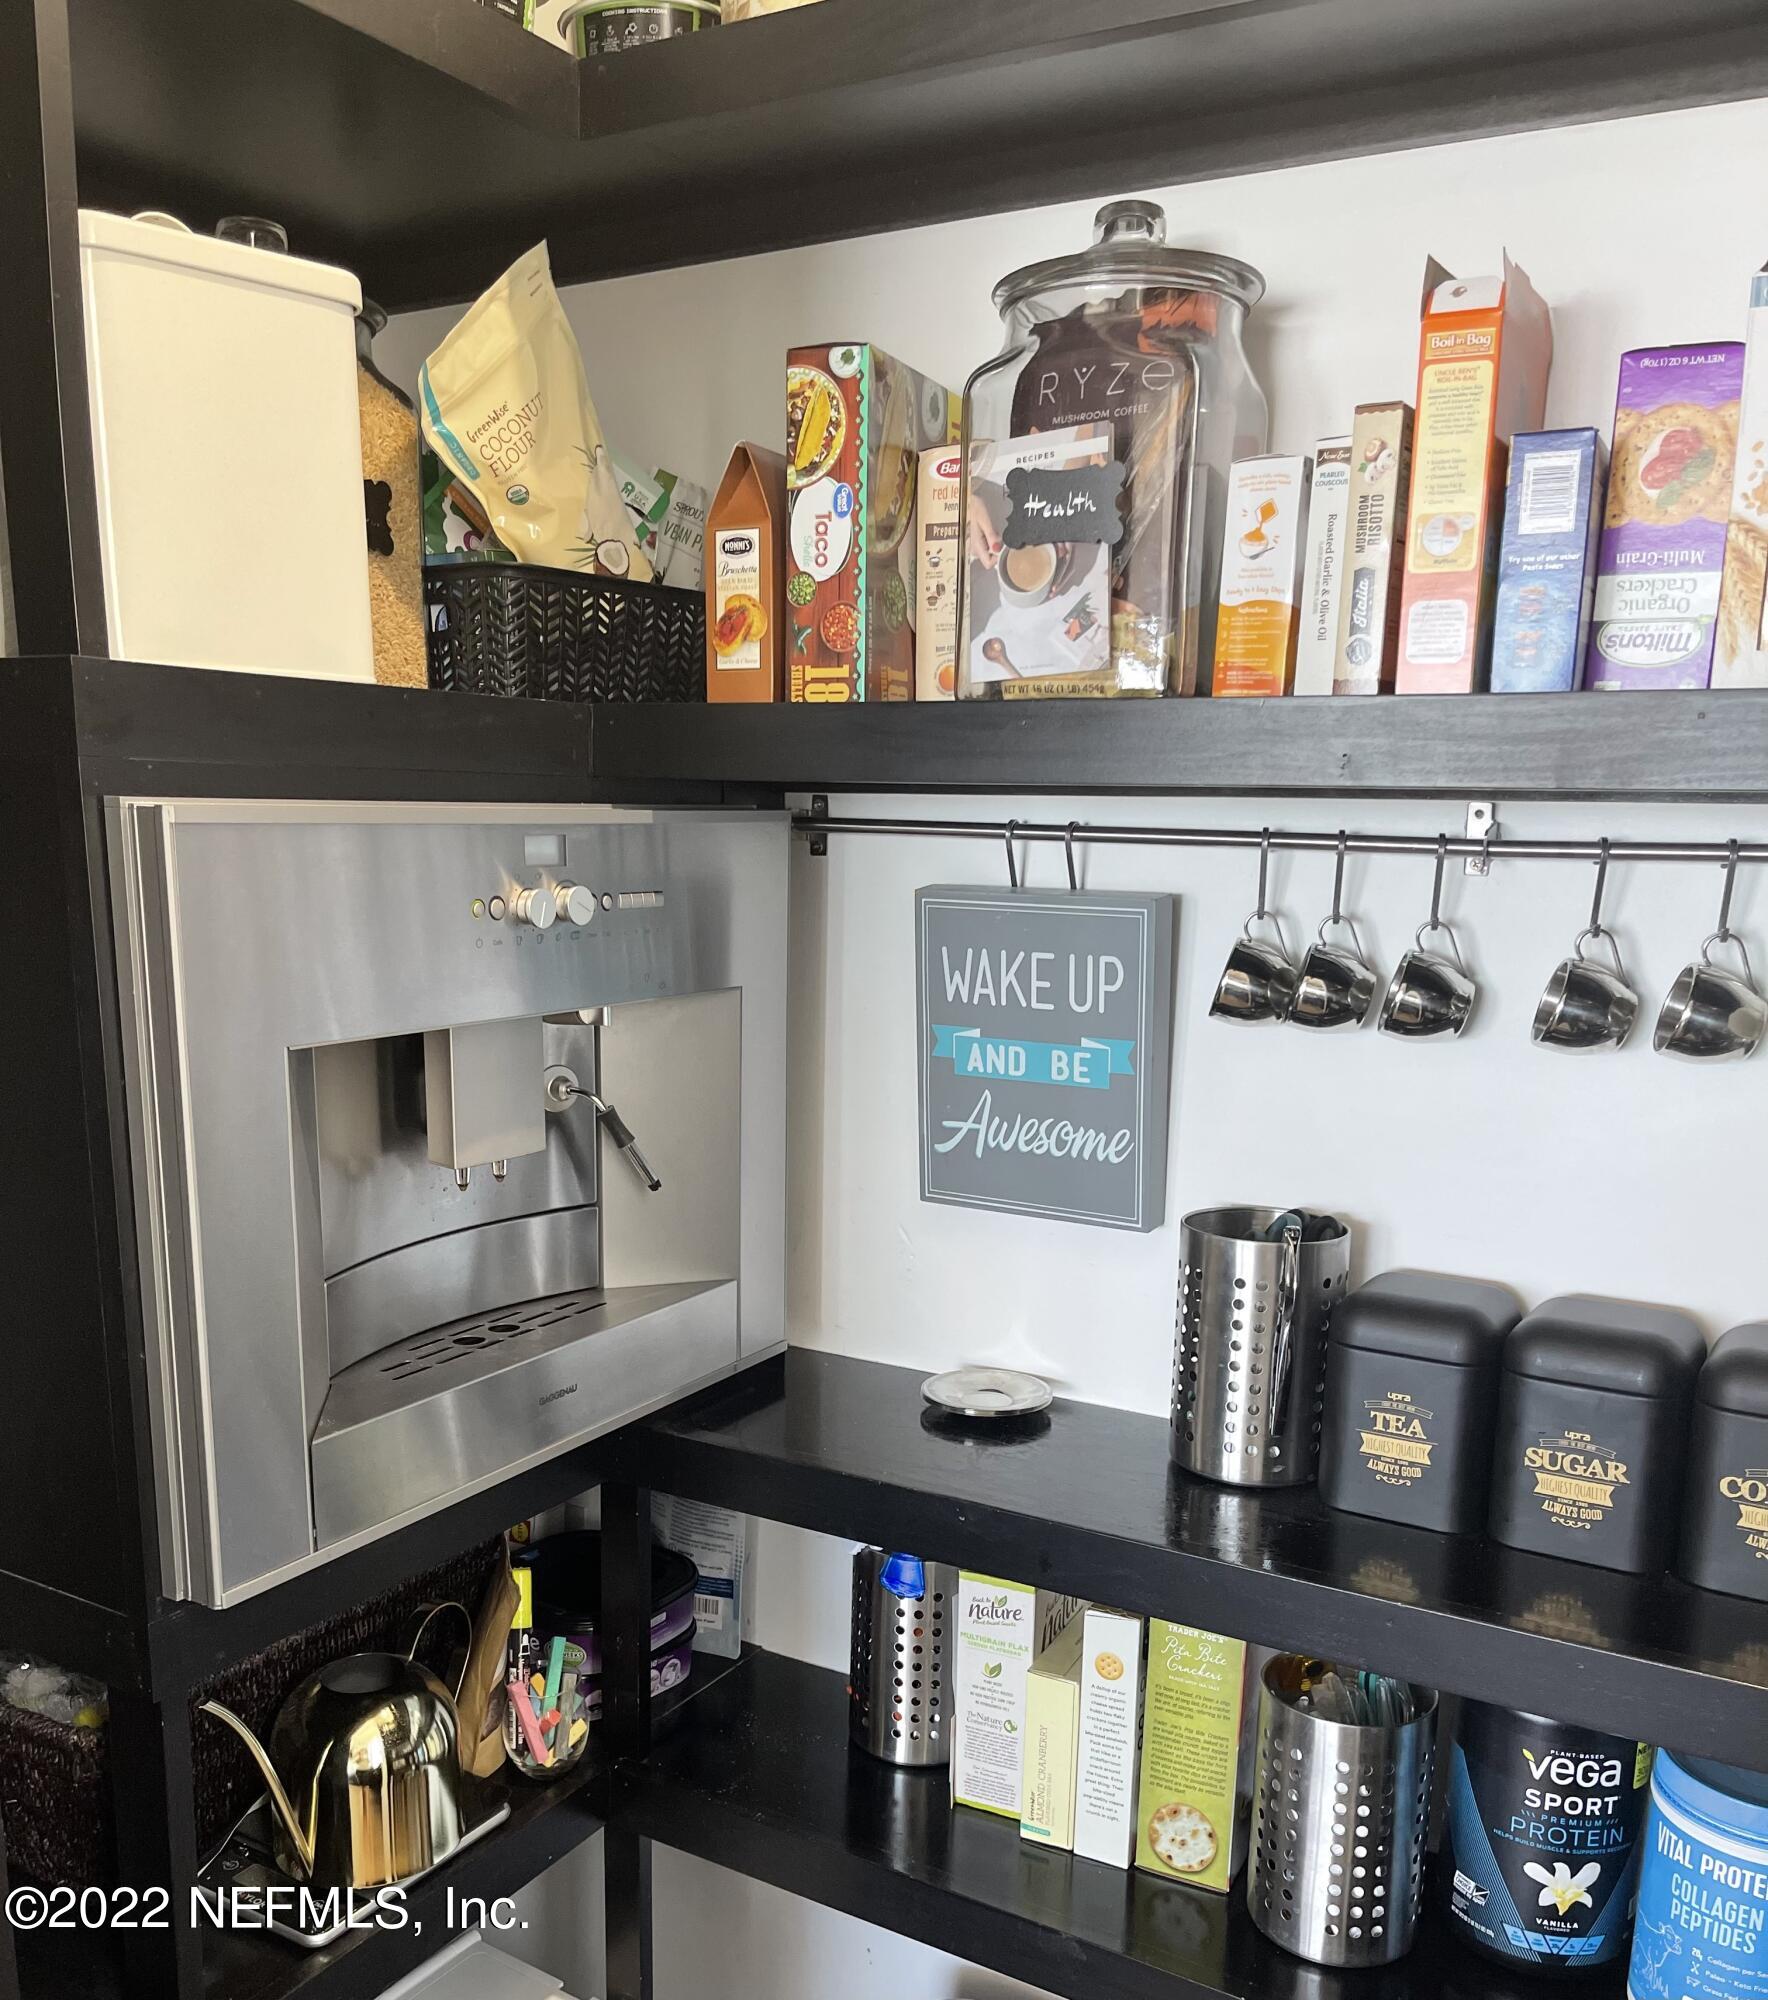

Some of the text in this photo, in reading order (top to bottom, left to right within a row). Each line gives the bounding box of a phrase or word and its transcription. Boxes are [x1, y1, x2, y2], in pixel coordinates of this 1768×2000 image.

[1431, 333, 1491, 348] Boil in Bag
[1669, 358, 1681, 366] OZ
[1682, 357, 1689, 365] 6
[1690, 355, 1707, 364] WT
[1709, 354, 1725, 363] NET
[466, 402, 509, 443] GreenWise
[480, 392, 544, 461] COCONUT
[1052, 403, 1149, 425] MUSHROOM COFFEE
[489, 431, 536, 478] FLOUR
[1016, 451, 1056, 465] RECIPES
[840, 487, 850, 513] Great
[933, 485, 948, 501] red
[1023, 491, 1097, 519] Health
[1355, 494, 1370, 554] MUSHROOM
[1367, 494, 1384, 545] RISOTTO
[724, 540, 750, 552] NONNI'S
[815, 511, 833, 568] Taco
[719, 561, 758, 577] Bruschetta
[1616, 551, 1706, 565] Multi-Grain
[1317, 514, 1337, 641] Roasted Garlic & Olive Oil
[1617, 578, 1698, 596] Crackers
[1618, 597, 1691, 616] Organic
[790, 665, 804, 703] SHELLS
[804, 664, 850, 703] 18
[1004, 685, 1015, 694] NET
[1018, 684, 1029, 694] WT
[941, 946, 1125, 1014] WAKE UP
[966, 1042, 1092, 1084] AND BE
[934, 1088, 1135, 1164] Awesome
[1370, 1410, 1427, 1439] TEA
[1365, 1437, 1427, 1460] HIGHEST QUALITY
[1366, 1458, 1400, 1475] ALWAYS
[1401, 1466, 1422, 1478] GOOD
[1524, 1447, 1631, 1484] SUGAR
[1540, 1477, 1608, 1502] HIGHEST QUALITY
[1720, 1476, 1768, 1504] CO
[1541, 1499, 1603, 1521] ALWAYS GOOD
[1745, 1534, 1768, 1550] ALW
[960, 1631, 1006, 1648] MULTIGRAIN
[1008, 1643, 1030, 1653] FLAX
[1168, 1624, 1226, 1644] TRADER JOE'S
[1161, 1635, 1229, 1667] Pita Bite
[1166, 1654, 1223, 1682] Crackers
[977, 1712, 1003, 1726] Nature
[1038, 1724, 1048, 1781] CRANBERRY
[1550, 1749, 1605, 1760] PLANT-BASED
[1035, 1783, 1045, 1824] ALMOND
[1524, 1788, 1620, 1816] SPORT
[1510, 1816, 1624, 1847] PROTEIN
[1541, 1814, 1603, 1828] PREMIUM
[1493, 1828, 1514, 1841] HELPS
[1515, 1837, 1535, 1847] BUILD
[1536, 1843, 1564, 1853] MUSCLE
[1657, 1820, 1694, 1870] VITAL
[1671, 1873, 1764, 1932] COLLAGEN
[1535, 1917, 1579, 1929] VANILLA
[1670, 1898, 1757, 1954] PEPTIDES
[1707, 1956, 1741, 1973] Collagen
[1742, 1969, 1755, 1977] per
